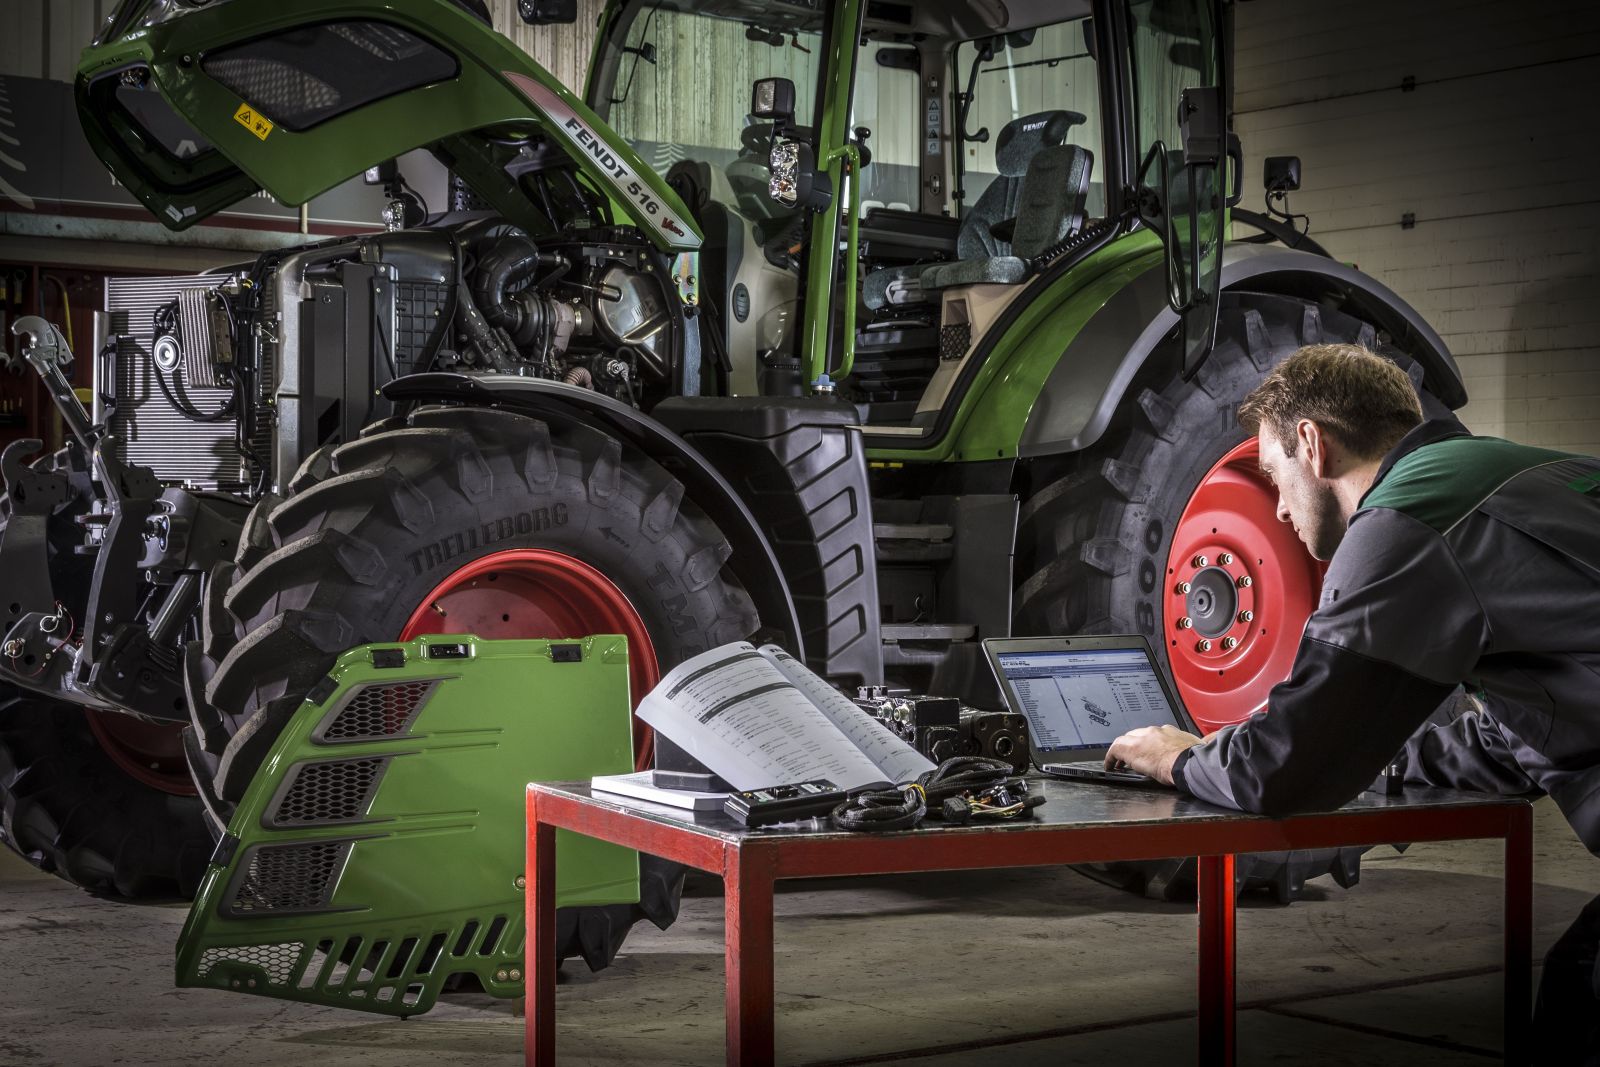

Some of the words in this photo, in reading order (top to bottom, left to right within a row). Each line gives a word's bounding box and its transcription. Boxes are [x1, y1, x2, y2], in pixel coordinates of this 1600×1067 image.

[1023, 120, 1047, 132] FENDT
[565, 117, 628, 179] FENDT
[626, 181, 660, 215] 516
[405, 502, 569, 577] TRELLEBORG
